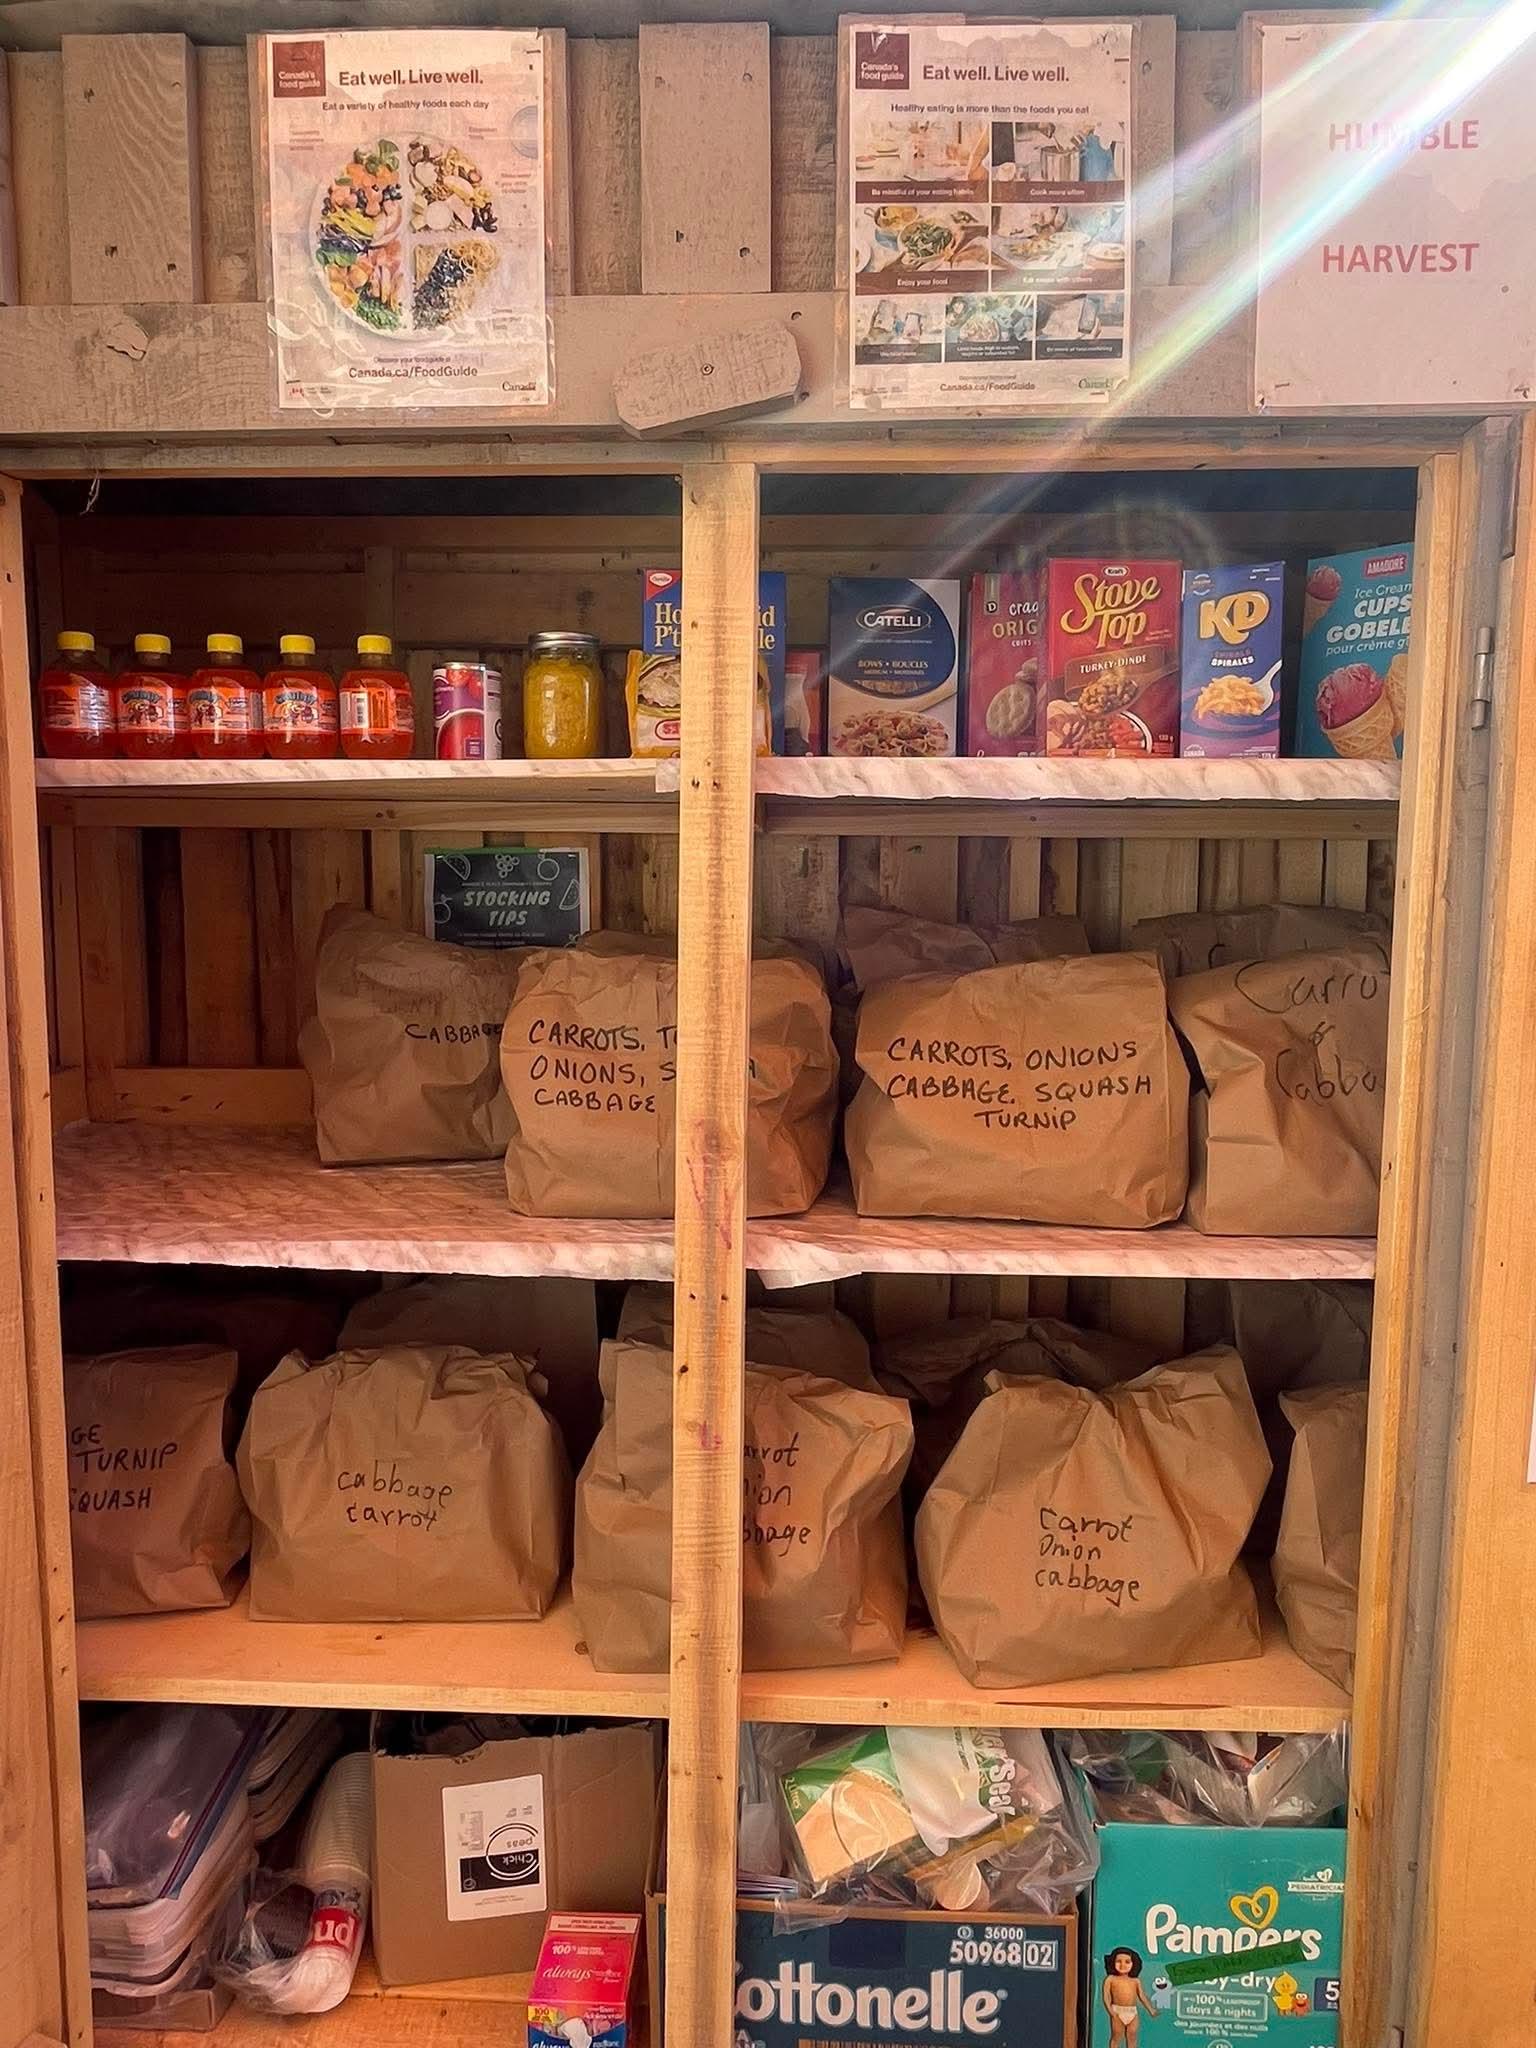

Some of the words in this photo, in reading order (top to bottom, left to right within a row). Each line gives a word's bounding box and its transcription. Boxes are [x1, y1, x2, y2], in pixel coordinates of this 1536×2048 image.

[861, 62, 899, 71] Canada's
[923, 65, 950, 81] Eat
[953, 65, 991, 81] well.
[994, 66, 1029, 81] Live
[1031, 66, 1070, 82] well.
[279, 80, 298, 88] food
[339, 71, 365, 86] Eat
[369, 69, 405, 85] well.
[409, 69, 442, 84] Live
[446, 68, 484, 84] well.
[860, 71, 880, 80] food
[881, 71, 904, 81] guide
[322, 102, 337, 111] Eat
[347, 102, 375, 112] variety
[378, 101, 387, 110] of
[389, 100, 421, 111] healthy
[422, 100, 448, 109] foods
[450, 100, 471, 109] each
[473, 100, 490, 110] day
[890, 104, 925, 114] Healthy
[926, 104, 954, 114] eating
[956, 104, 964, 113] is
[991, 104, 1011, 113] than
[1012, 104, 1027, 113] the
[1029, 104, 1054, 113] foods
[1056, 106, 1073, 115] you
[1074, 106, 1090, 114] eat
[1329, 119, 1480, 152] HUBLE
[1323, 243, 1480, 273] HARVEST
[915, 279, 932, 287] your
[932, 277, 948, 285] food
[348, 366, 478, 378] Canada.ca/FoodGuide
[940, 381, 1036, 393] Canada.ca/FoodGuide
[1107, 567, 1125, 575] Kraft
[1354, 588, 1373, 598] Ice
[1060, 573, 1161, 634] Stove
[1354, 594, 1412, 618] CUPS
[863, 611, 922, 628] CATELLI
[1199, 591, 1270, 645] KP
[1095, 609, 1147, 649] Top
[1326, 643, 1356, 657] pour
[1357, 639, 1395, 652] crème
[1211, 656, 1254, 667] SPIRALES
[463, 890, 551, 906] STOCKING
[488, 910, 528, 927] TIPS
[528, 1020, 646, 1052] CARROTS,
[887, 1037, 1012, 1071] CARROTS,
[1025, 1040, 1138, 1071] ONIONS
[530, 1055, 646, 1087] ONIONS,
[1035, 1075, 1151, 1103] SQUASH
[534, 1088, 656, 1113] CABBAGE
[73, 1442, 178, 1473] TURNIP
[338, 1460, 453, 1509] cabbage
[1035, 1564, 1140, 1608] cabbage
[507, 1836, 533, 1848] peas
[502, 1852, 534, 1865] Chick
[985, 1927, 1024, 1941] 36000
[1146, 1903, 1322, 1961] Pampers
[950, 1942, 1021, 1965] 50968
[1026, 1945, 1052, 1967] 02
[543, 1965, 592, 1982] always
[735, 1961, 1000, 2034] ottonelle
[1325, 1980, 1340, 2001] 5
[1186, 2007, 1211, 2017] days
[1214, 2007, 1221, 2016] &
[1224, 2007, 1257, 2018] nights
